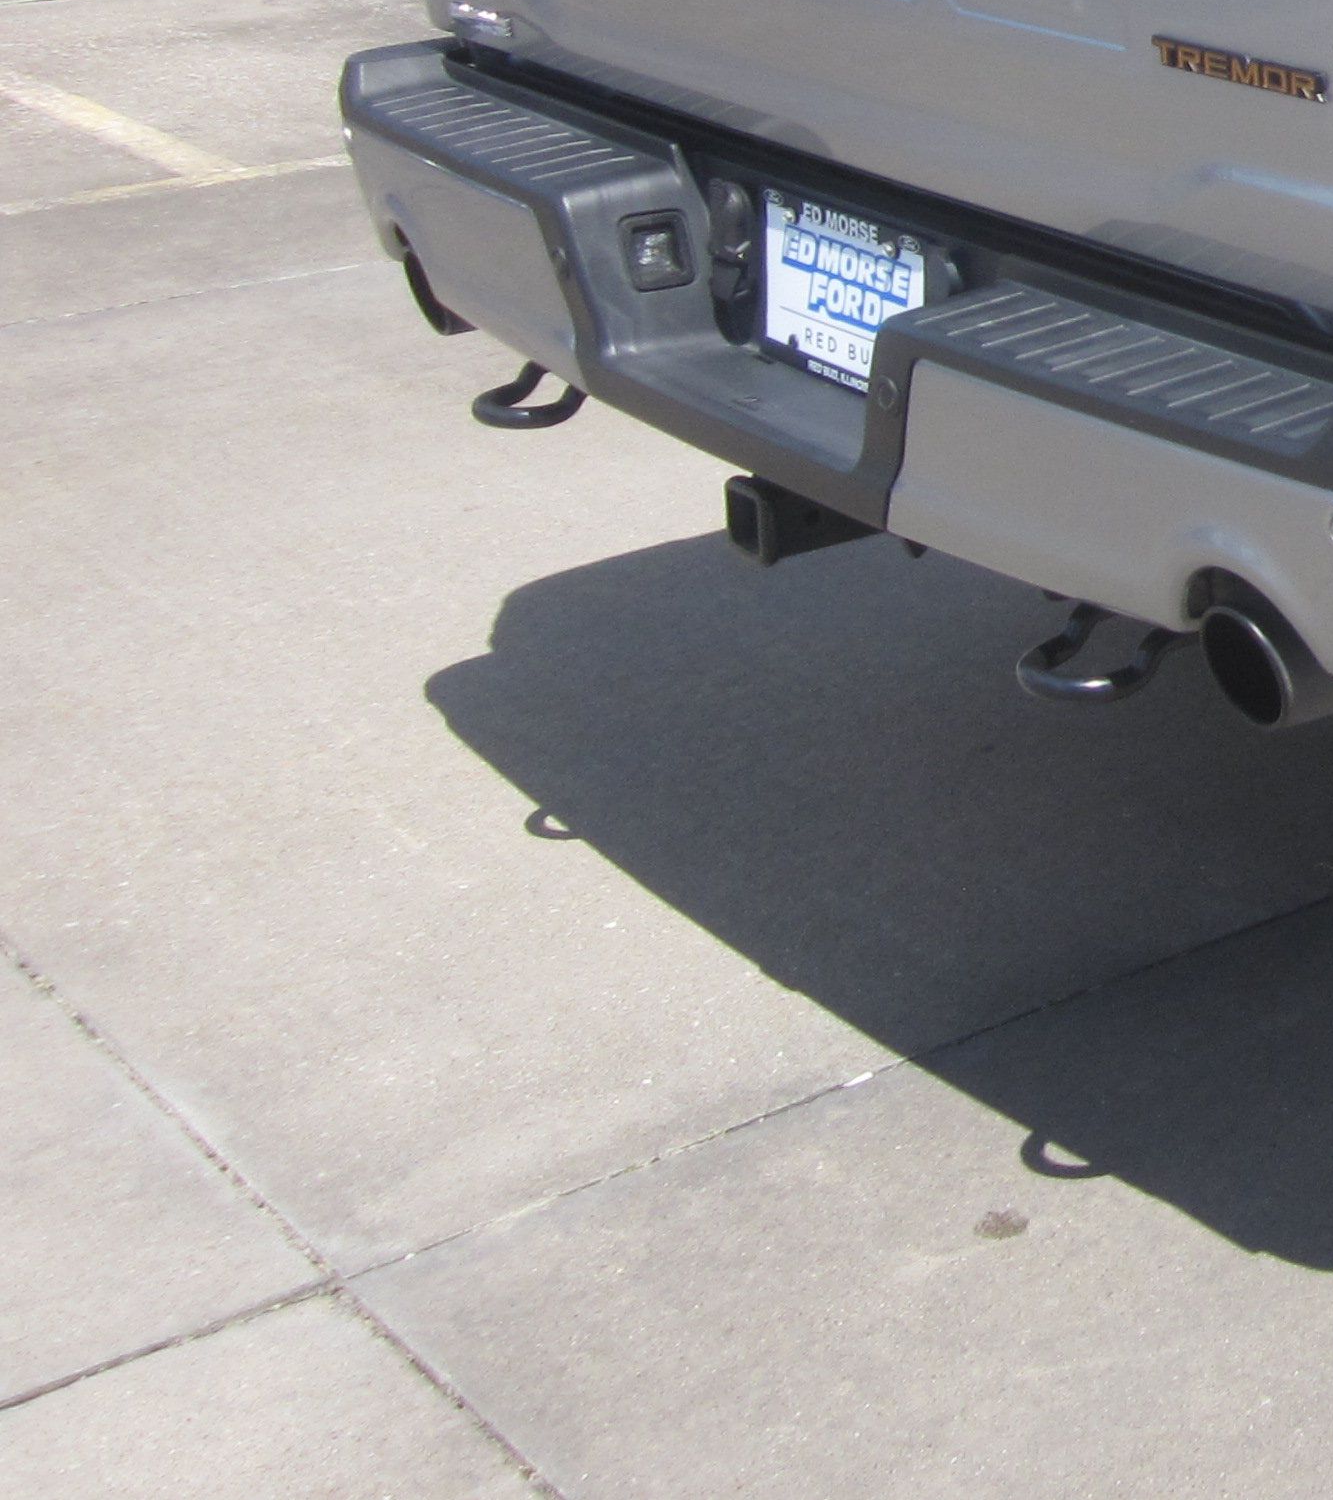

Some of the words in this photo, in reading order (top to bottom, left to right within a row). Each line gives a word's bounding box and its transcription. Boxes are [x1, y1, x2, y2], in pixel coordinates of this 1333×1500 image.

[1151, 34, 1328, 104] TREMOR
[801, 202, 822, 225] ED
[824, 210, 880, 244] MORSE
[783, 225, 817, 268] ED
[817, 236, 912, 304] MORSE
[808, 272, 884, 330] FORD
[804, 328, 838, 353] RED
[847, 343, 870, 364] BU
